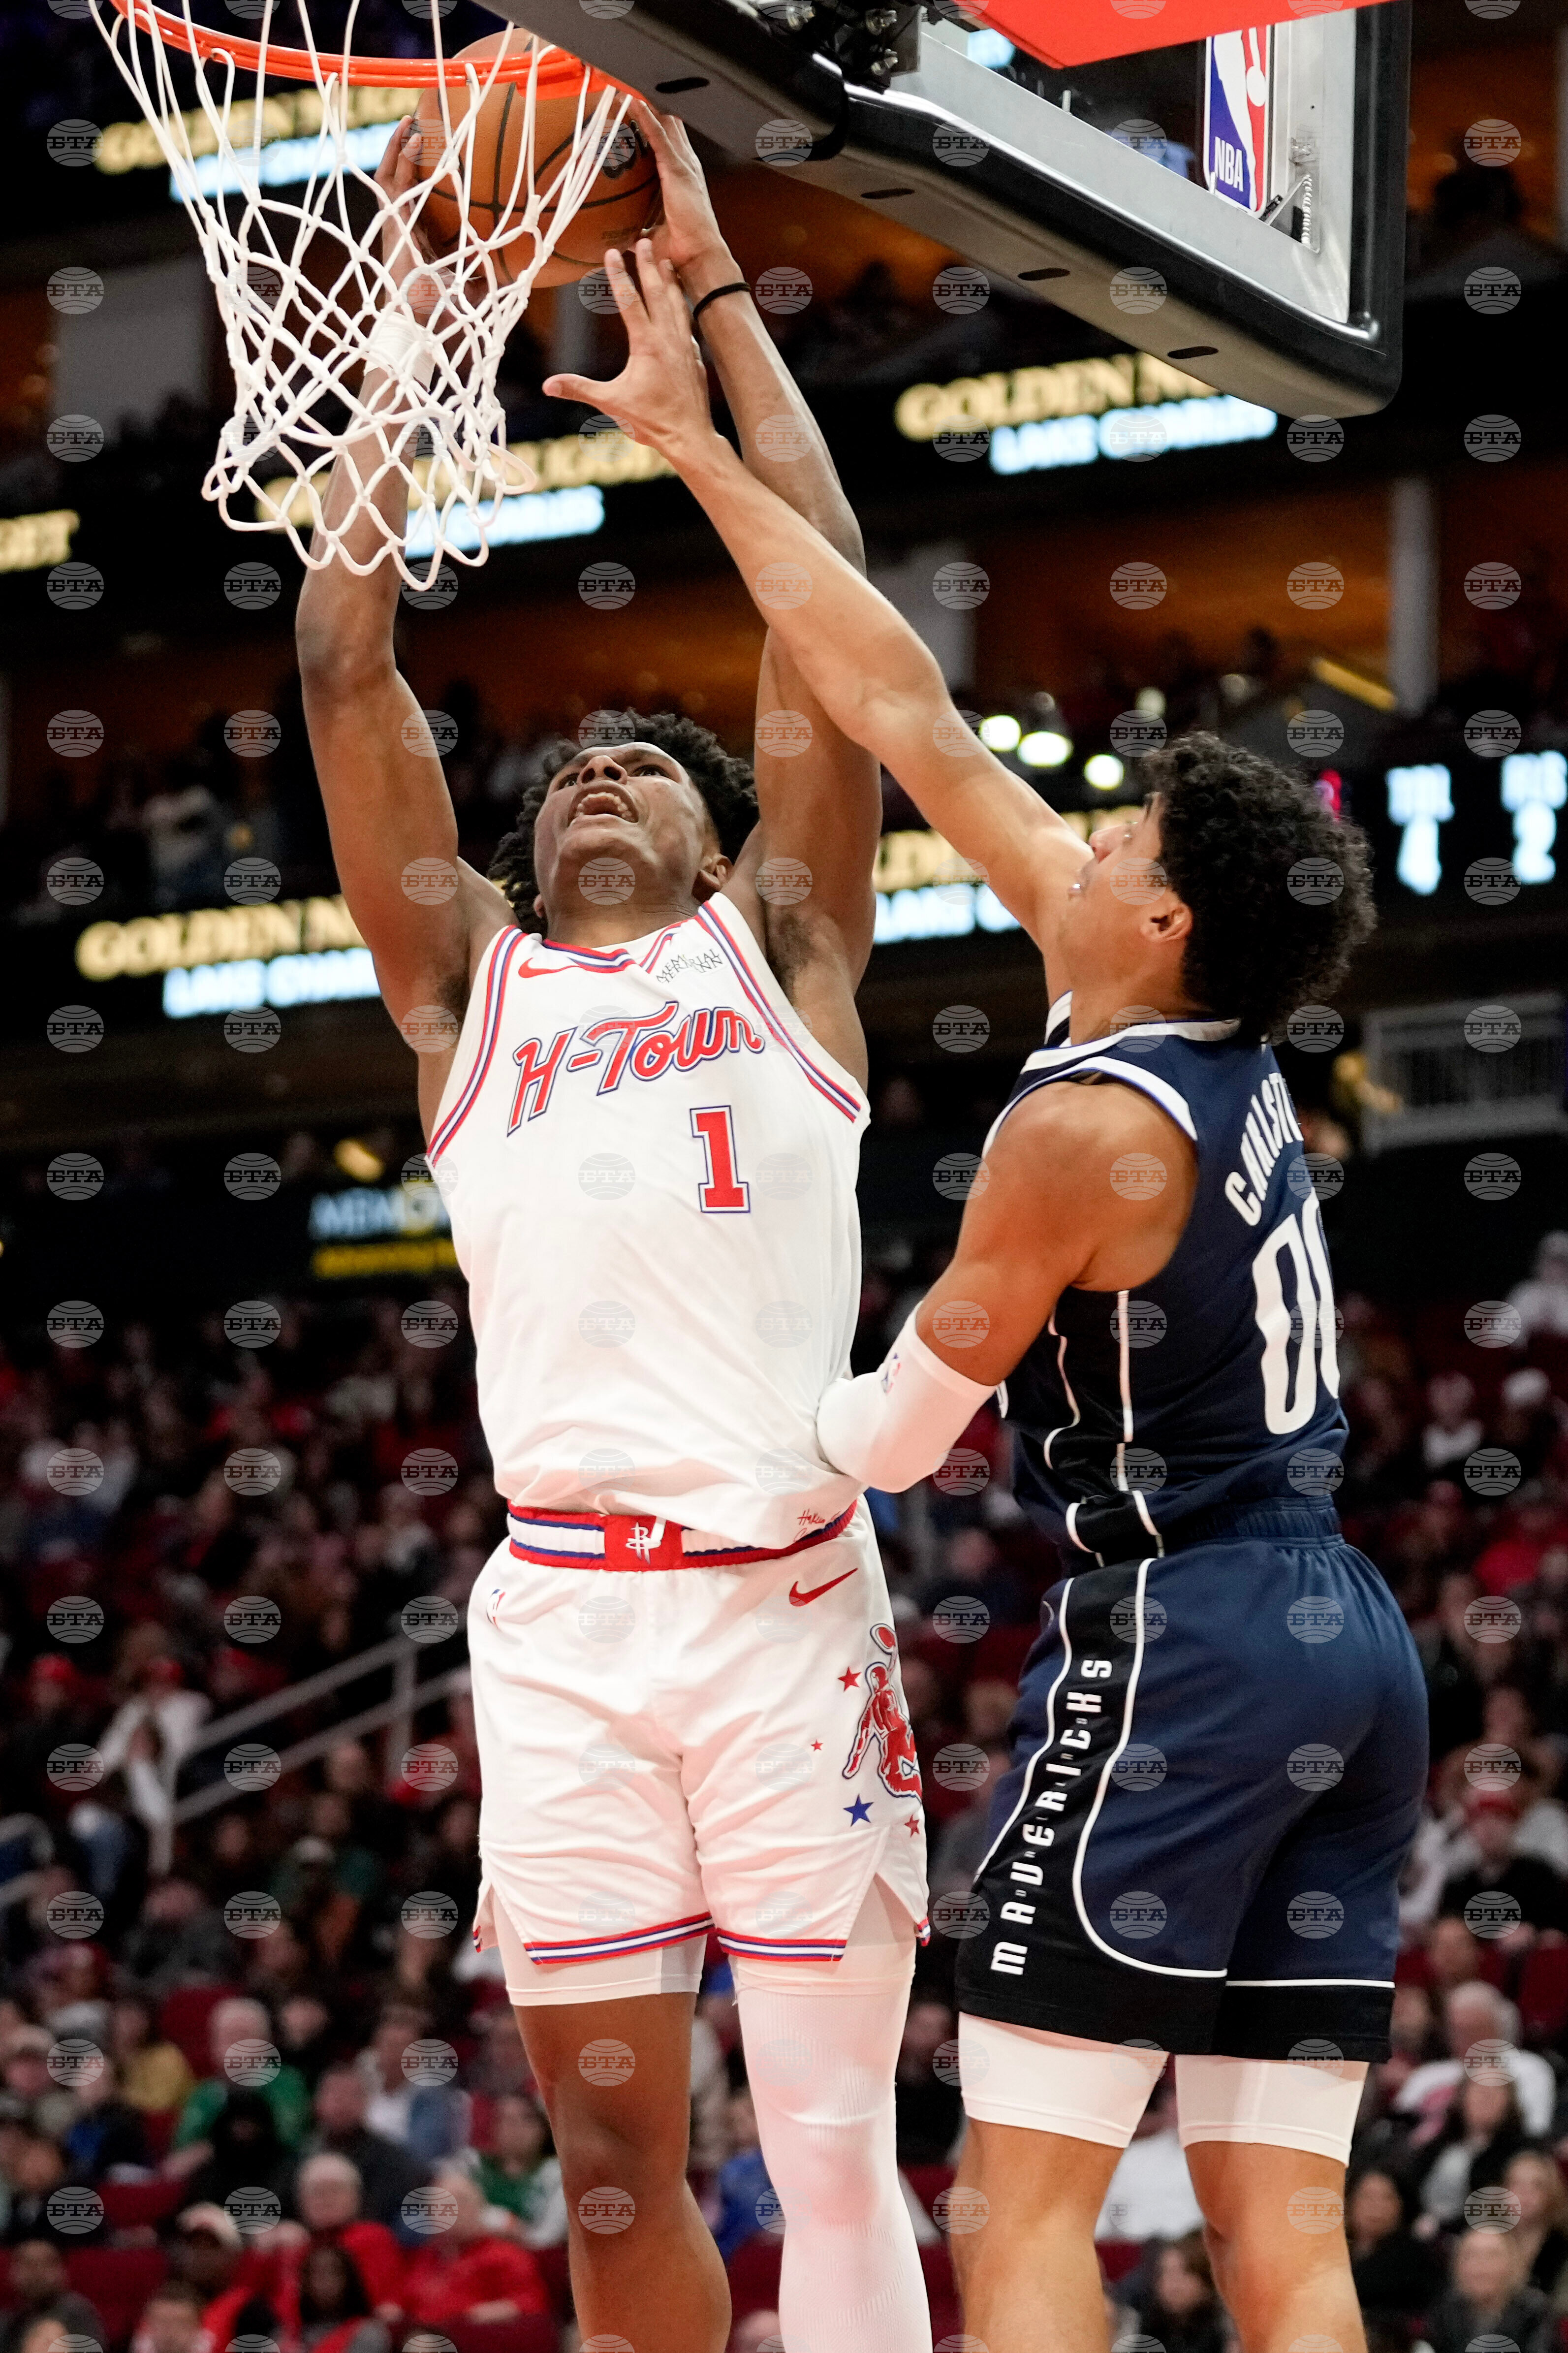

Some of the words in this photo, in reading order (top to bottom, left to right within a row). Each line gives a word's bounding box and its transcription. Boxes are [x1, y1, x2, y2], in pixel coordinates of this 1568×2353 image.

[1215, 136, 1244, 192] NBA
[507, 1001, 765, 1137] H-Town
[690, 1105, 751, 1213] 1
